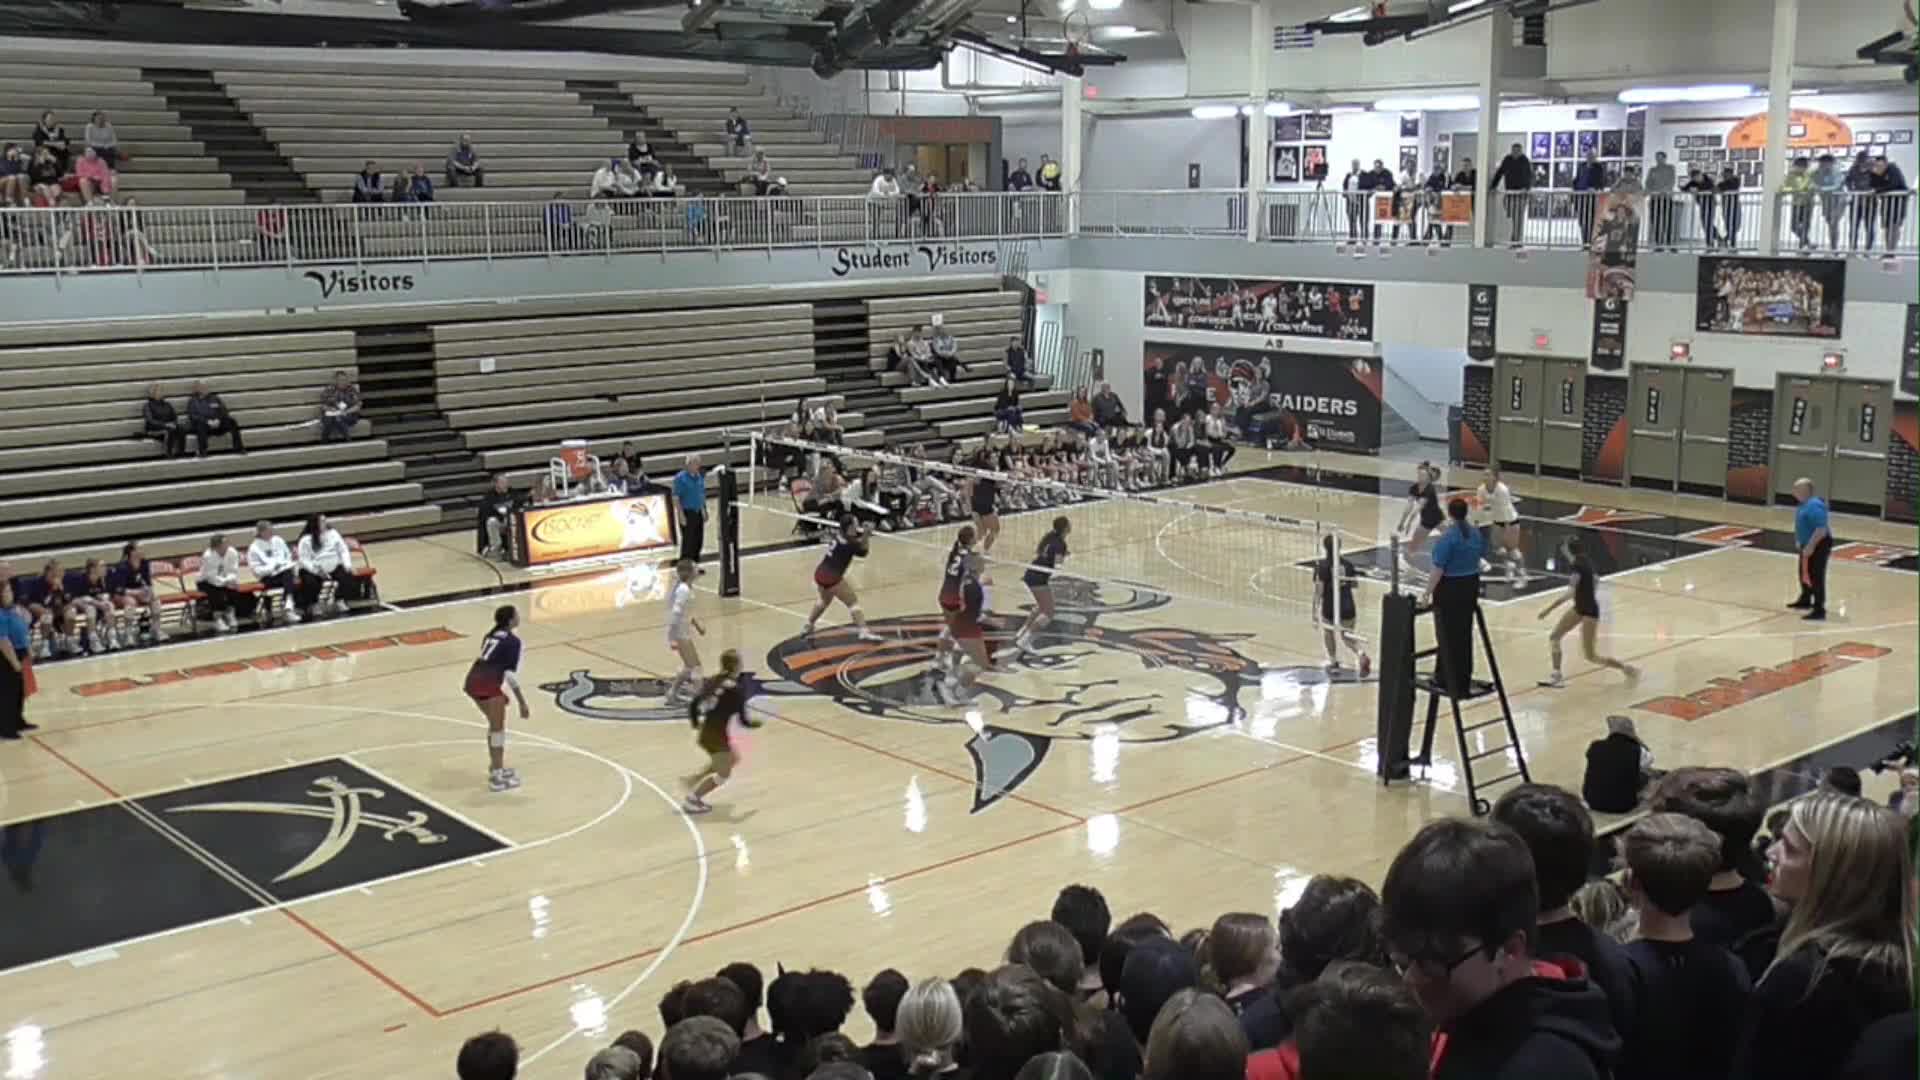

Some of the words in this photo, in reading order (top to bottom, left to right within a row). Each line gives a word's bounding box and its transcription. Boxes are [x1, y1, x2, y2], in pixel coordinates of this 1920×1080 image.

[832, 248, 910, 276] Student
[918, 246, 997, 272] Visitors
[304, 269, 415, 299] Visitors
[1269, 392, 1359, 416] RAIDERS
